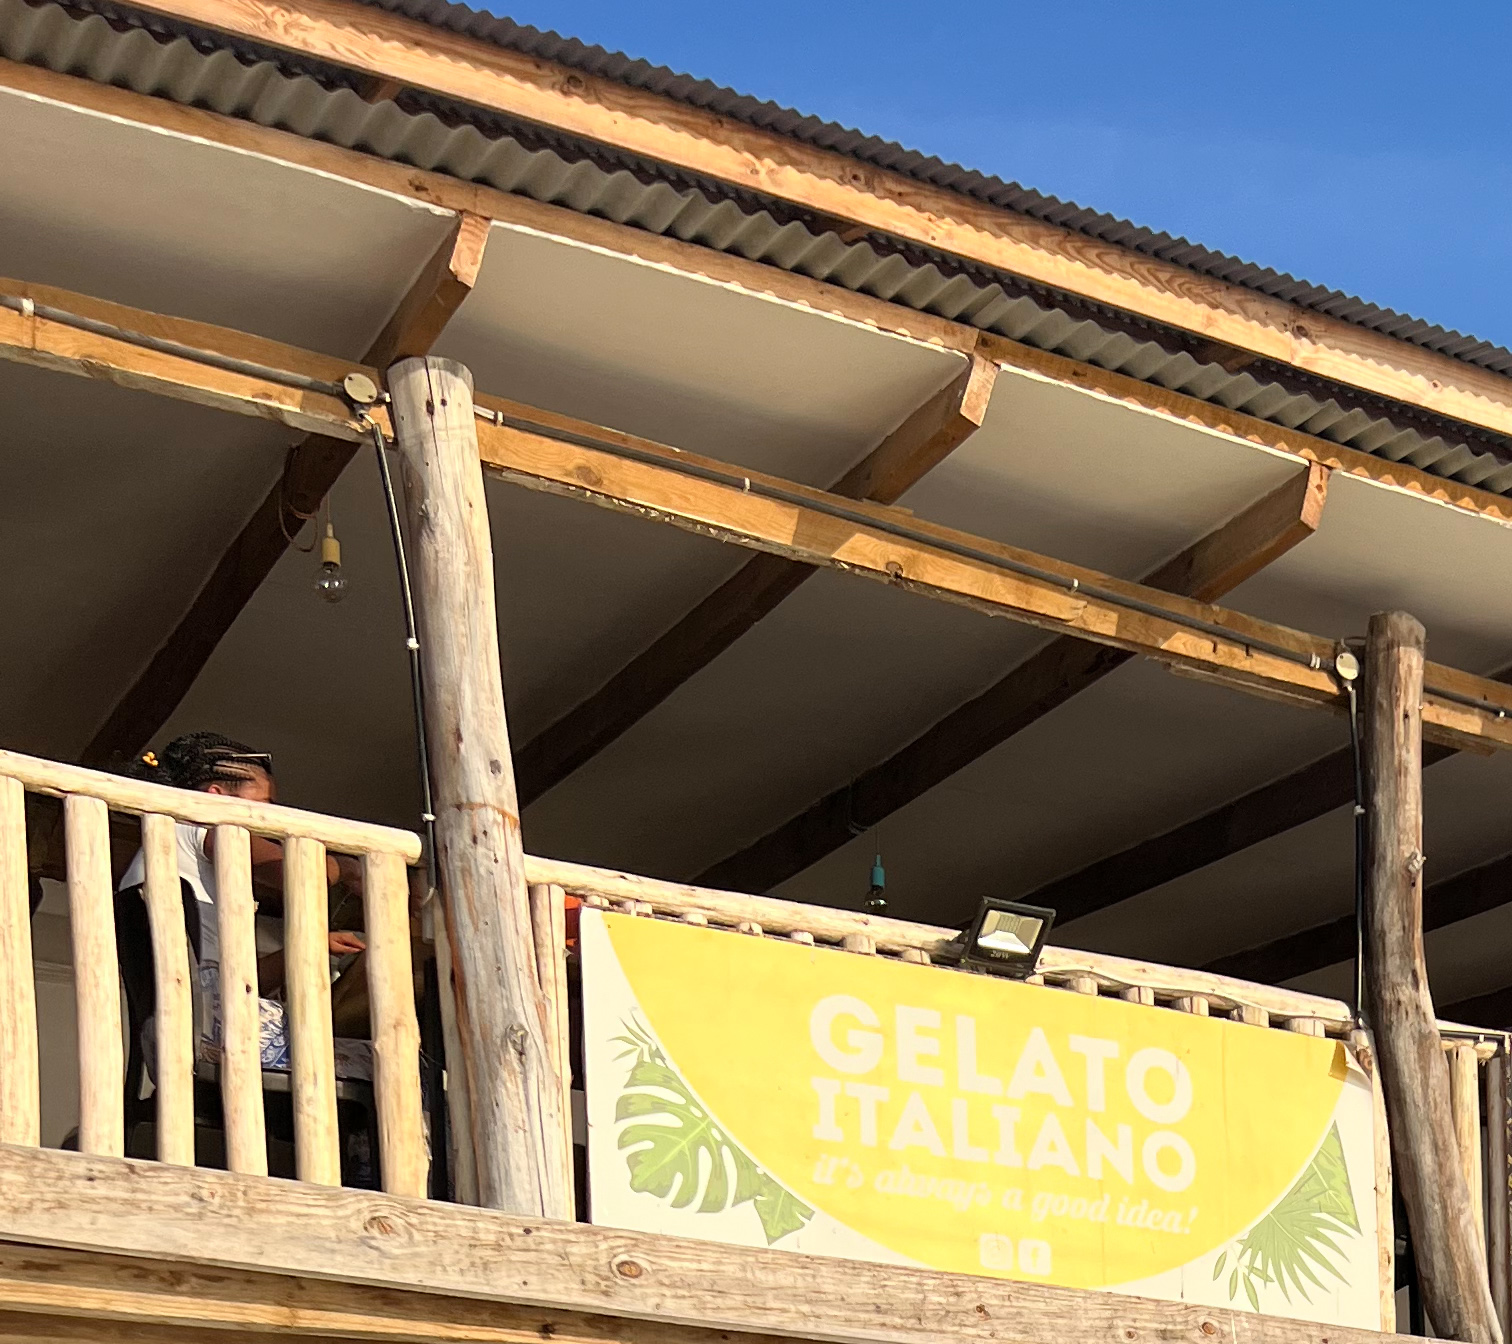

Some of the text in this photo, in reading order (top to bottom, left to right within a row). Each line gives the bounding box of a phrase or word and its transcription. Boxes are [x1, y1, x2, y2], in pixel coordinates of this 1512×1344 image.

[808, 993, 1195, 1125] GELATO
[810, 1078, 1198, 1193] ITALIANO
[811, 1153, 1199, 1235] it's always a good idea!
